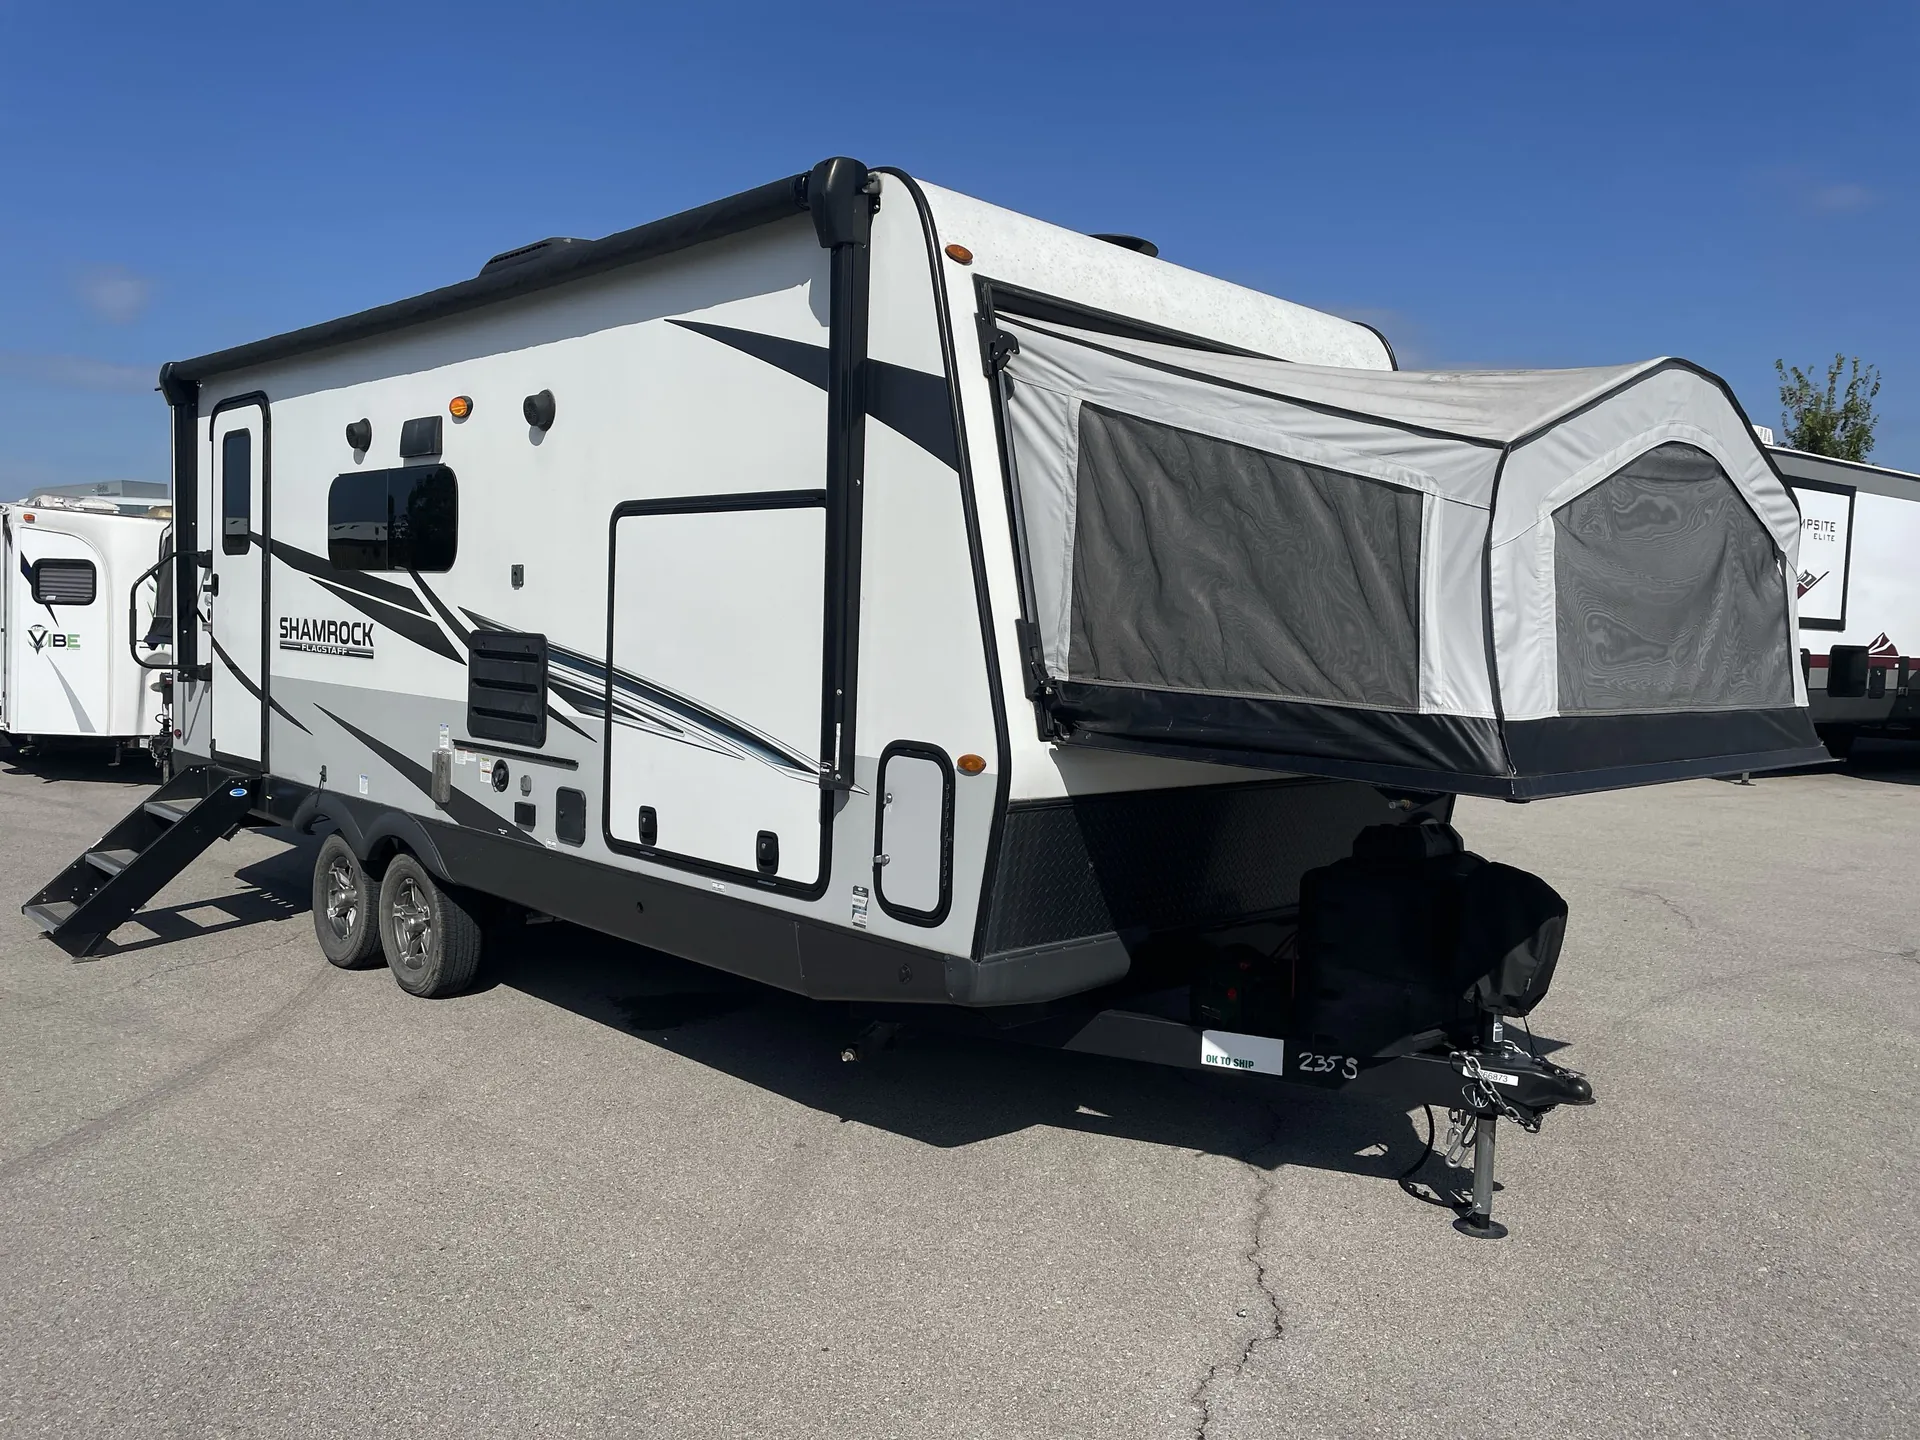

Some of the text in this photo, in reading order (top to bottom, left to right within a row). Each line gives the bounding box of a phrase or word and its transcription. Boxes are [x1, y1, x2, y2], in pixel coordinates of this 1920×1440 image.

[1813, 532, 1835, 542] ELITE
[279, 616, 374, 647] SHAMROCK
[27, 629, 81, 655] VIBE
[301, 643, 348, 655] FLAGSTAFF
[1205, 1054, 1254, 1069] OK TO SHIP
